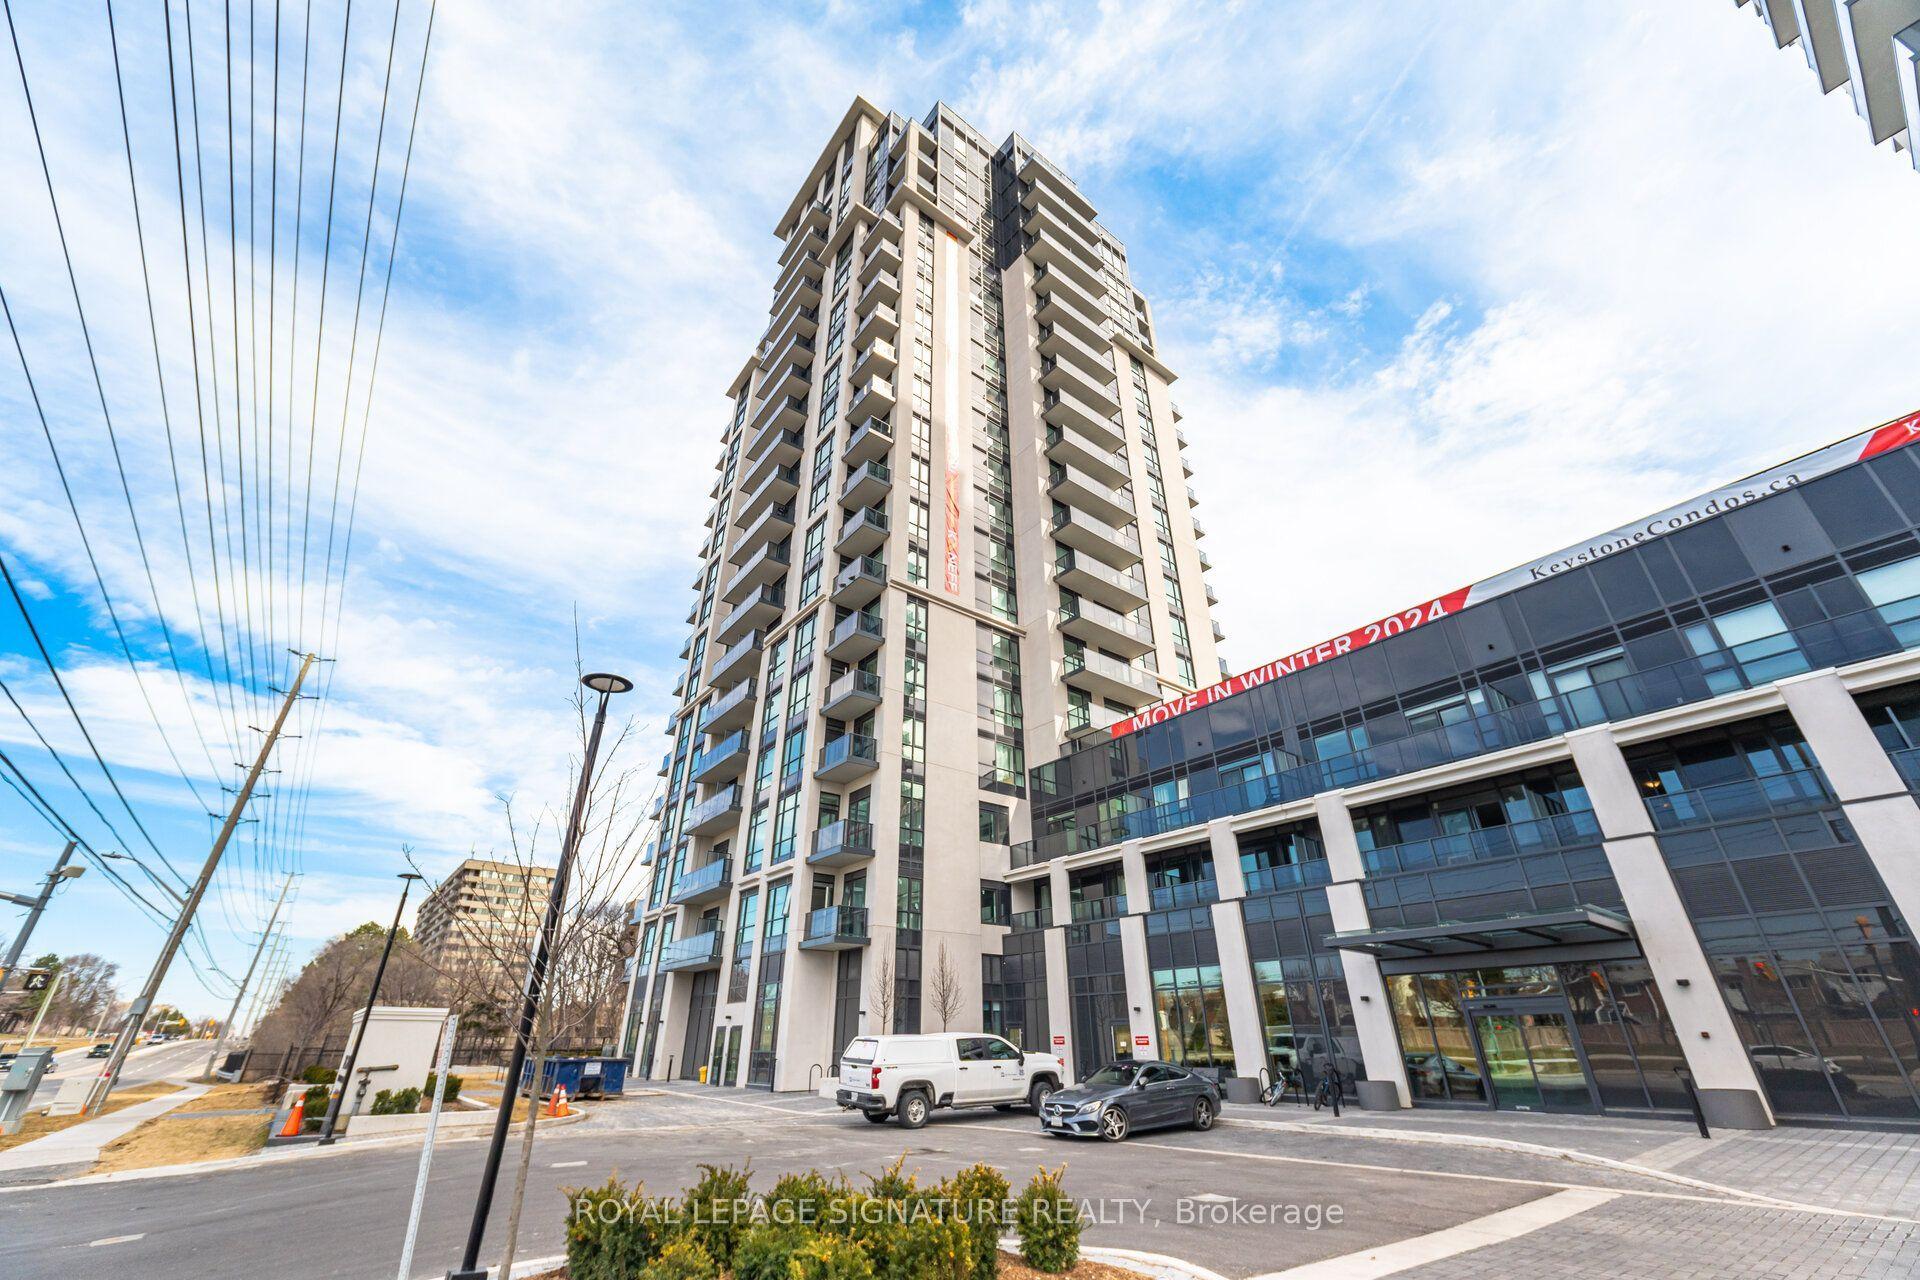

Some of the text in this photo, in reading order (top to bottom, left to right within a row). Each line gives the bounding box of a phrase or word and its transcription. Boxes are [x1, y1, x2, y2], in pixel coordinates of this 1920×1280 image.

[1132, 599, 1448, 731] MOVE IN WINTER 2024
